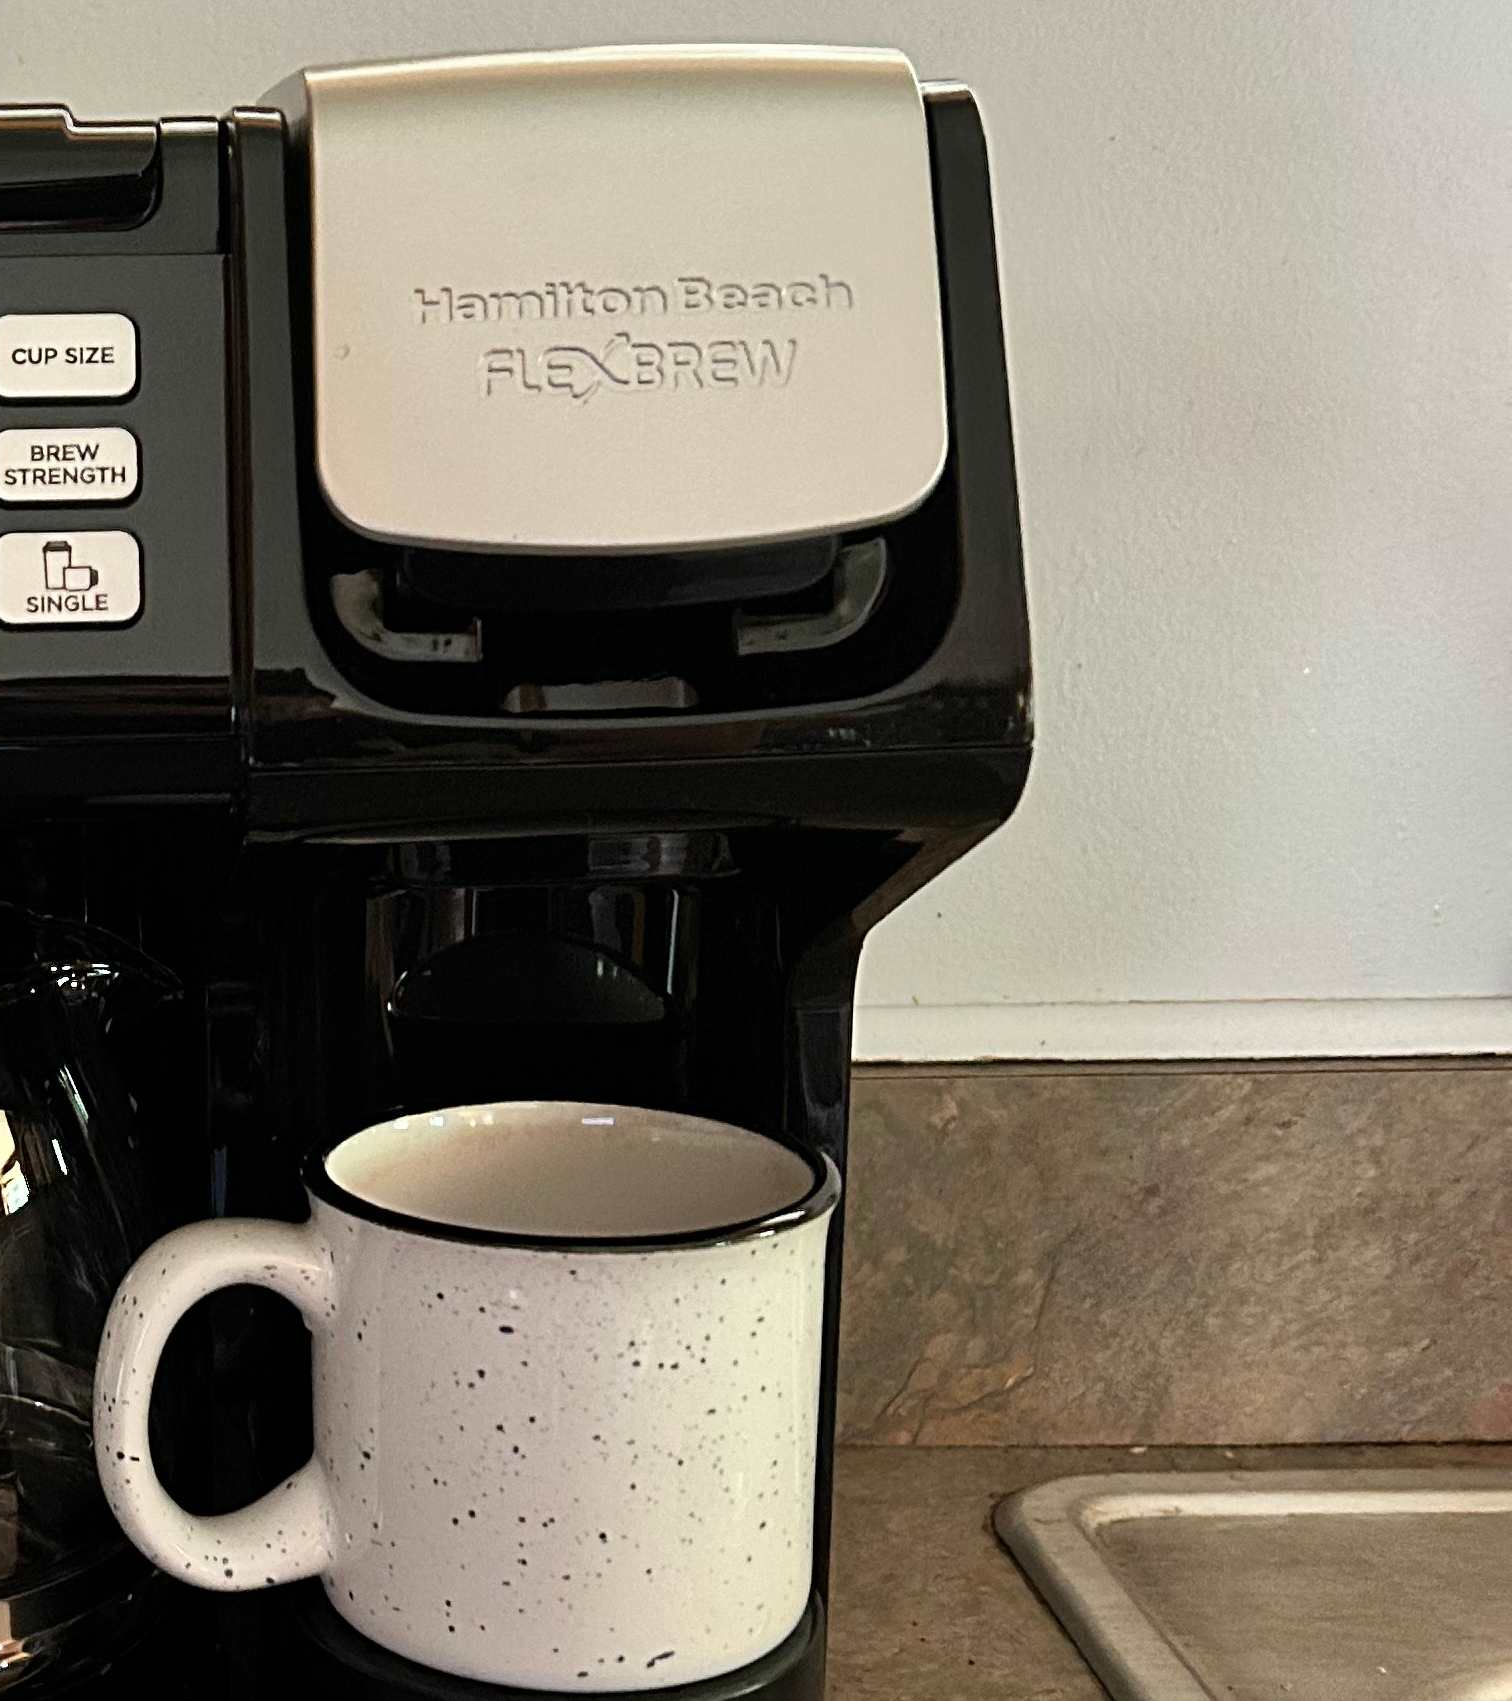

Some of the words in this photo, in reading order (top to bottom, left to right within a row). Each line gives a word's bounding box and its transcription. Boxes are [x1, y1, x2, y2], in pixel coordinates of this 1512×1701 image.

[413, 282, 669, 325] Hamilton
[678, 273, 855, 311] Beach
[11, 347, 58, 365] CUP
[65, 346, 116, 365] SIZE
[30, 443, 100, 463] BREW
[4, 466, 127, 486] STRENGTH
[26, 593, 109, 614] SINGLE
